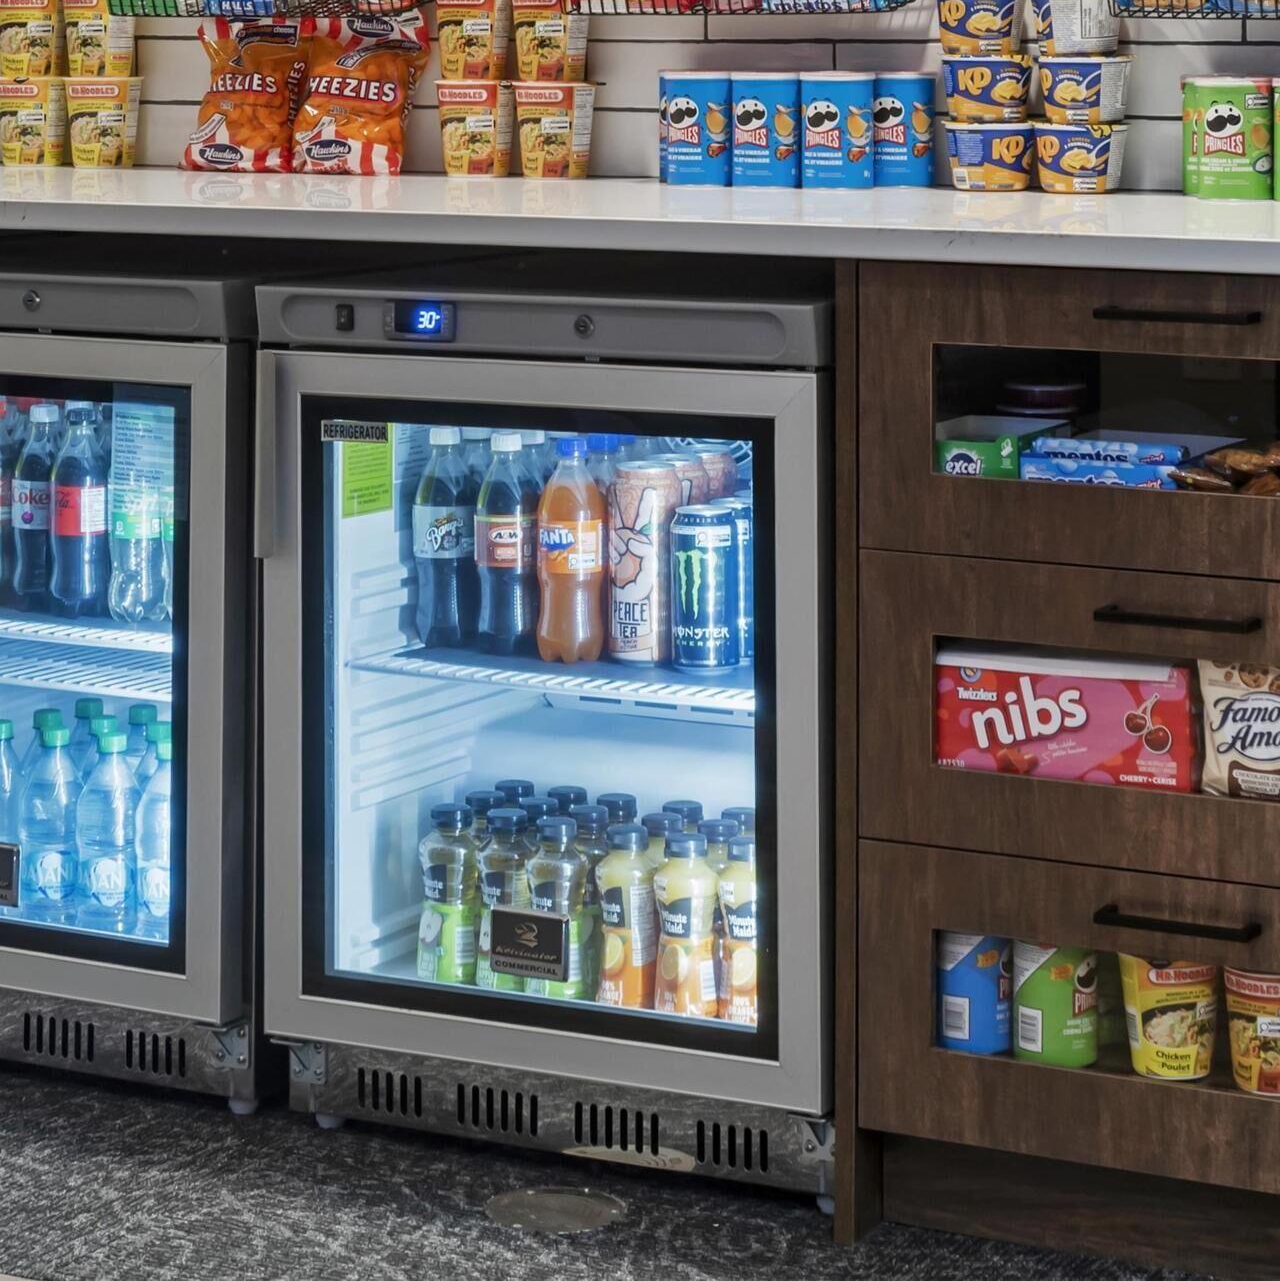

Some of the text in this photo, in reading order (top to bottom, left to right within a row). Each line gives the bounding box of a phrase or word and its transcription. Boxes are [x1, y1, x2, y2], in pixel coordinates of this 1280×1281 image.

[222, 1, 253, 11] HALLS
[939, 0, 966, 27] KD
[353, 18, 393, 33] Hawkins
[958, 66, 993, 96] KD
[80, 86, 115, 95] NOODLES
[448, 90, 483, 100] NOODLES
[524, 91, 559, 100] NOODLES
[310, 143, 350, 158] Hawkins
[992, 135, 1024, 165] KD
[1205, 134, 1243, 156] PRINGLES
[203, 147, 244, 162] Hawkins
[323, 424, 388, 440] REFRIGERATOR
[946, 460, 982, 475] excel
[540, 527, 575, 545] FANTA
[957, 687, 998, 701] Twizzlers
[971, 675, 1087, 749] nibs
[1119, 774, 1148, 784] CHERRY
[495, 960, 558, 976] COMMERCIAL
[1235, 979, 1280, 996] NOODLES
[1156, 1050, 1191, 1060] Chicken
[1161, 1062, 1190, 1071] Poulet
